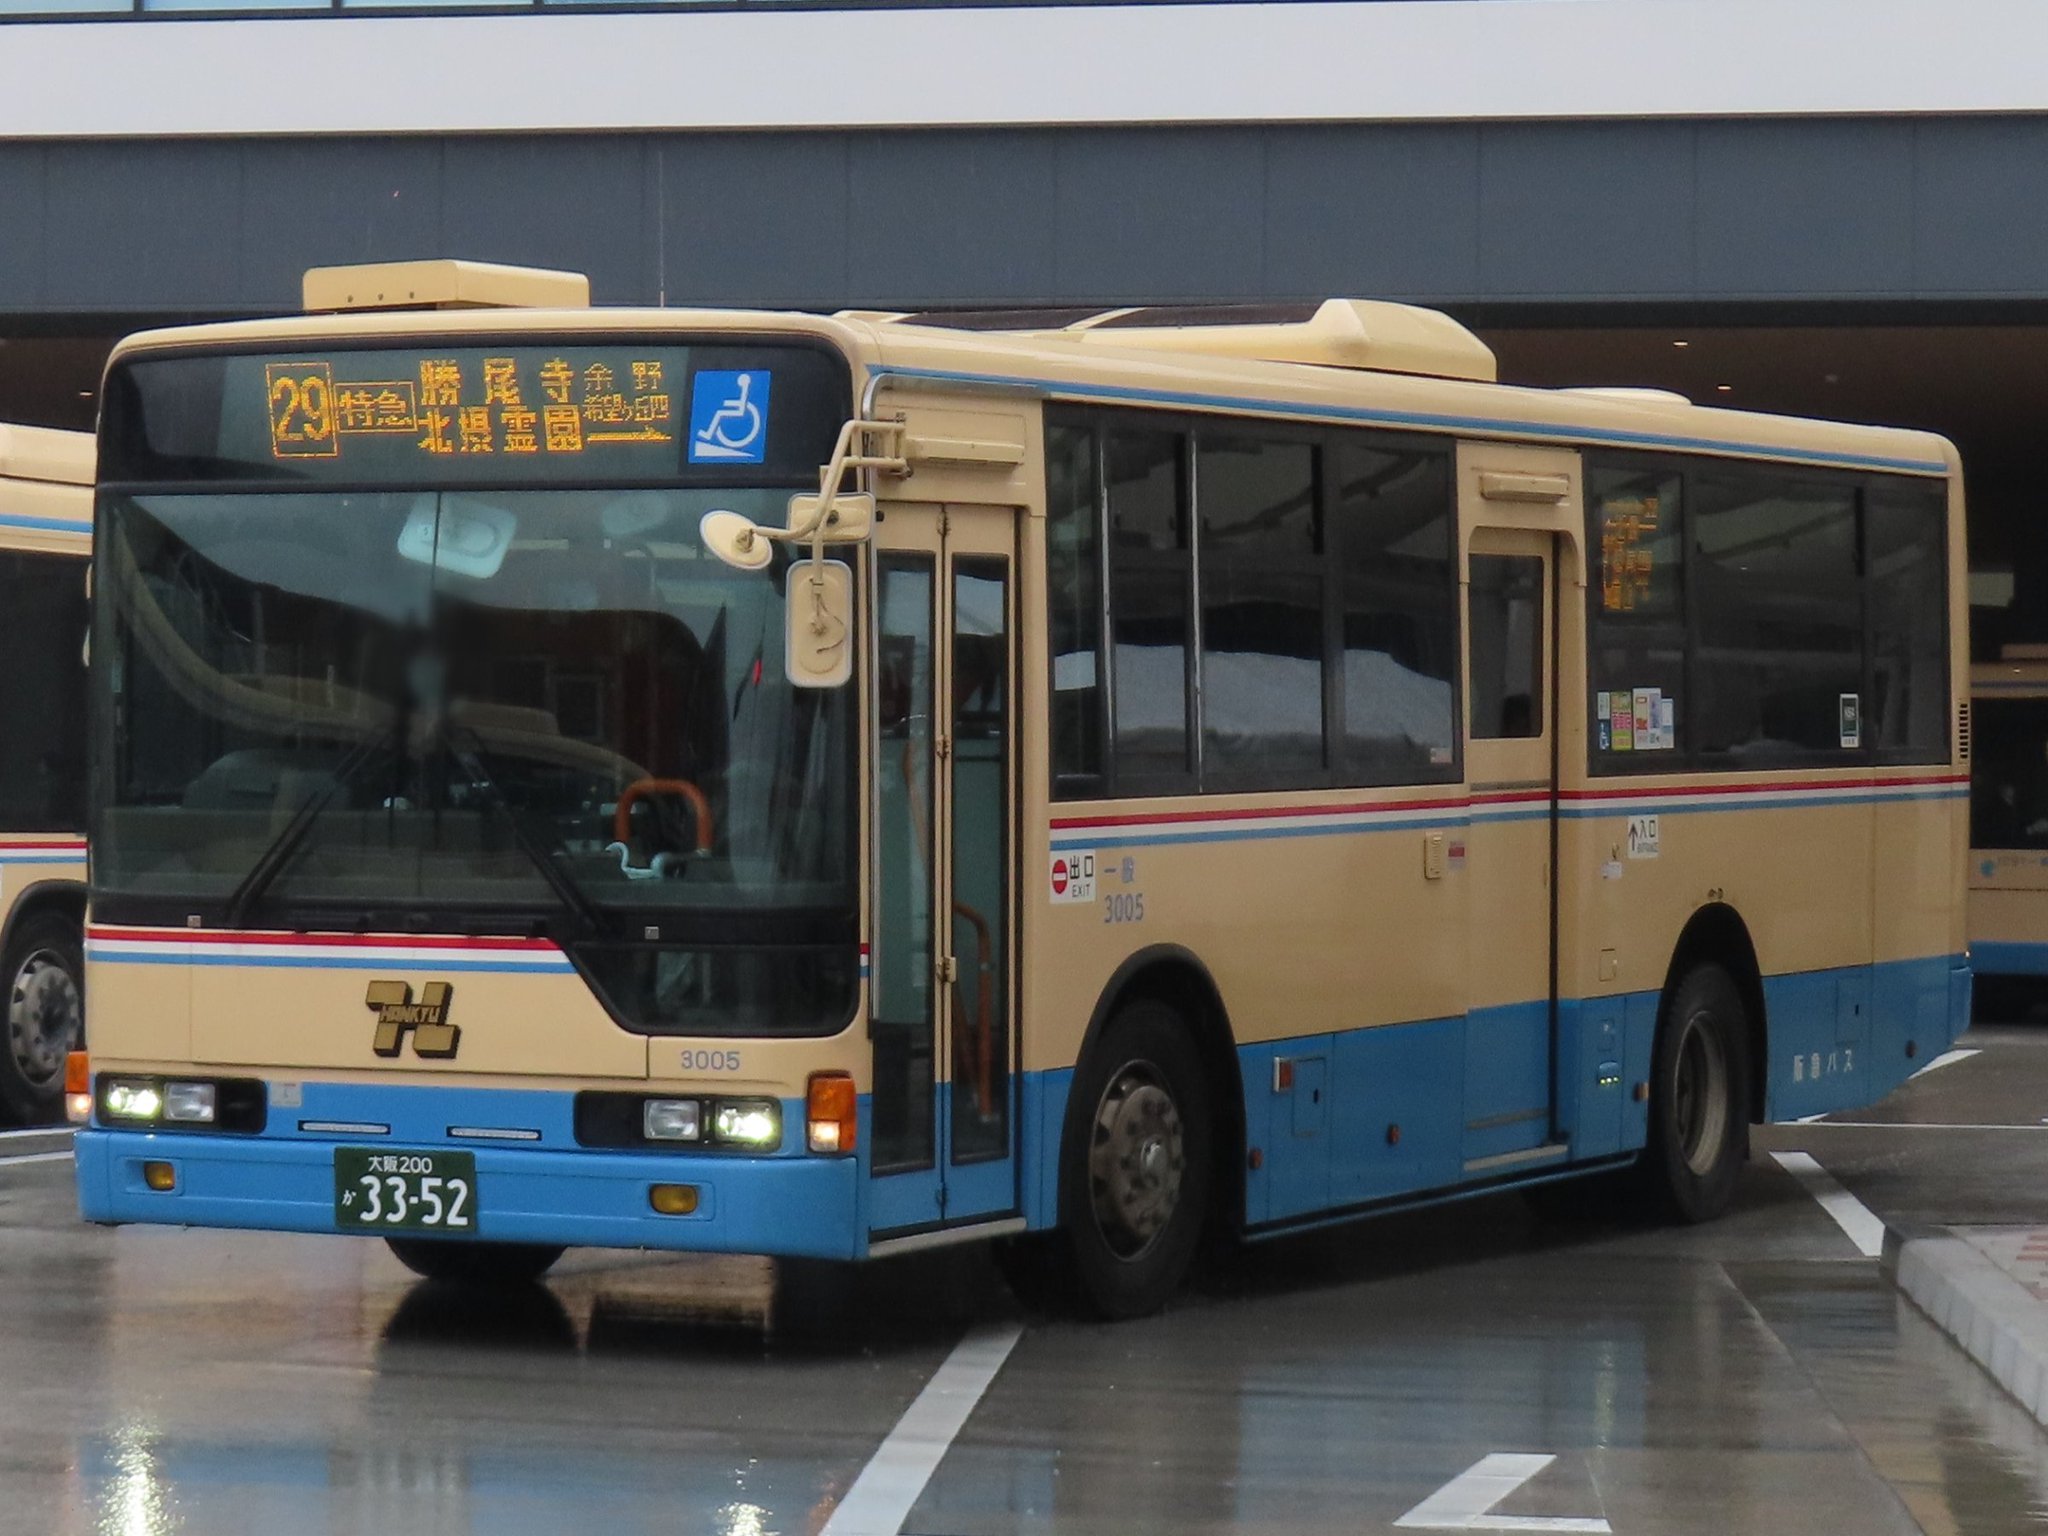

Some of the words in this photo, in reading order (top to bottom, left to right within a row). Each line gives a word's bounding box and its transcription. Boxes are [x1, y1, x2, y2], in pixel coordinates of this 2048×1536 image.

[420, 357, 574, 406] 勝尾寺
[584, 362, 662, 390] 余野
[273, 376, 332, 442] 29
[339, 389, 413, 427] 特急
[1639, 819, 1656, 839] 入口
[1069, 855, 1094, 880] 出口
[1071, 883, 1091, 898] EXIT
[1103, 892, 1144, 923] 3005
[380, 1004, 441, 1024] HANKYU
[681, 1049, 740, 1071] 3005
[341, 1189, 357, 1206] か
[360, 1175, 469, 1226] 33-52
